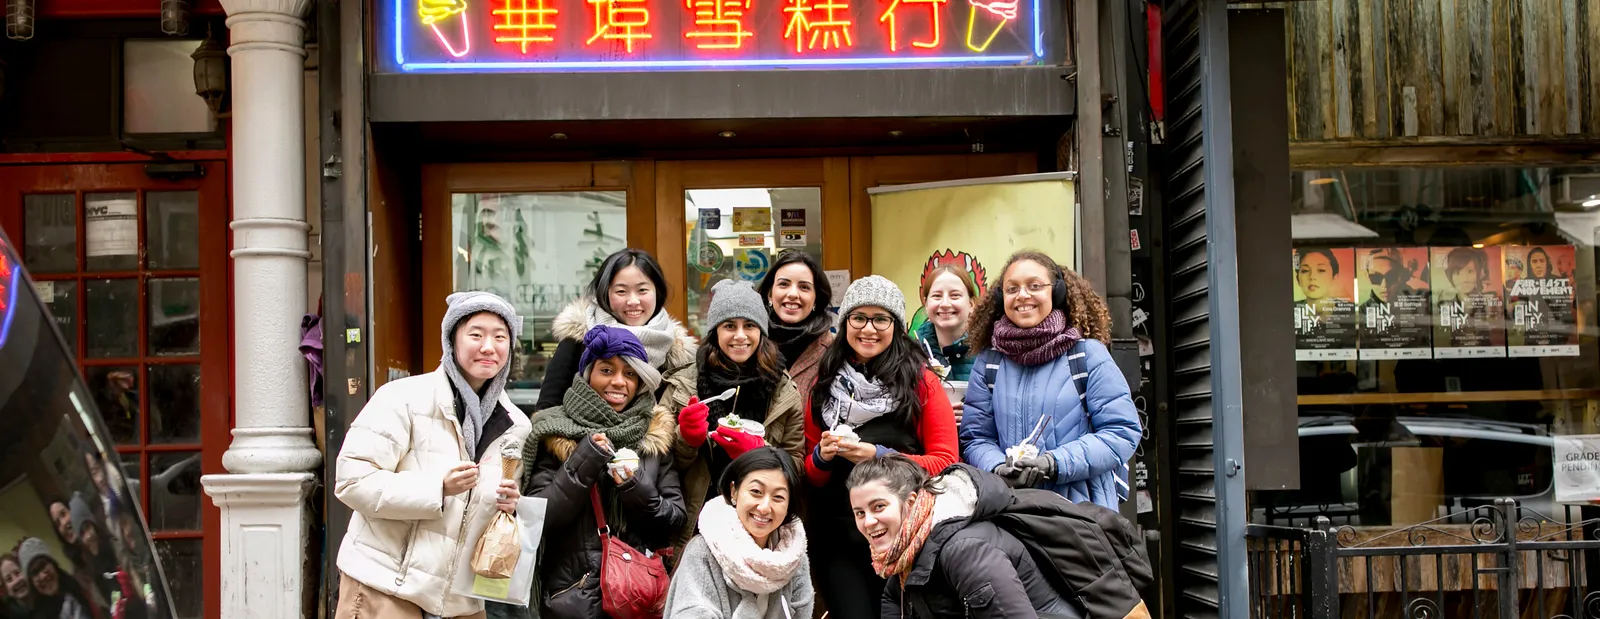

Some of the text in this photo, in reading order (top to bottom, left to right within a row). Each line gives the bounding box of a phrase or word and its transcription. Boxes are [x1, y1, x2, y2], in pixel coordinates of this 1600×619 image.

[1515, 286, 1573, 296] MOVEMENT
[1566, 452, 1600, 461] GRADE
[1561, 463, 1600, 472] PENDIN
